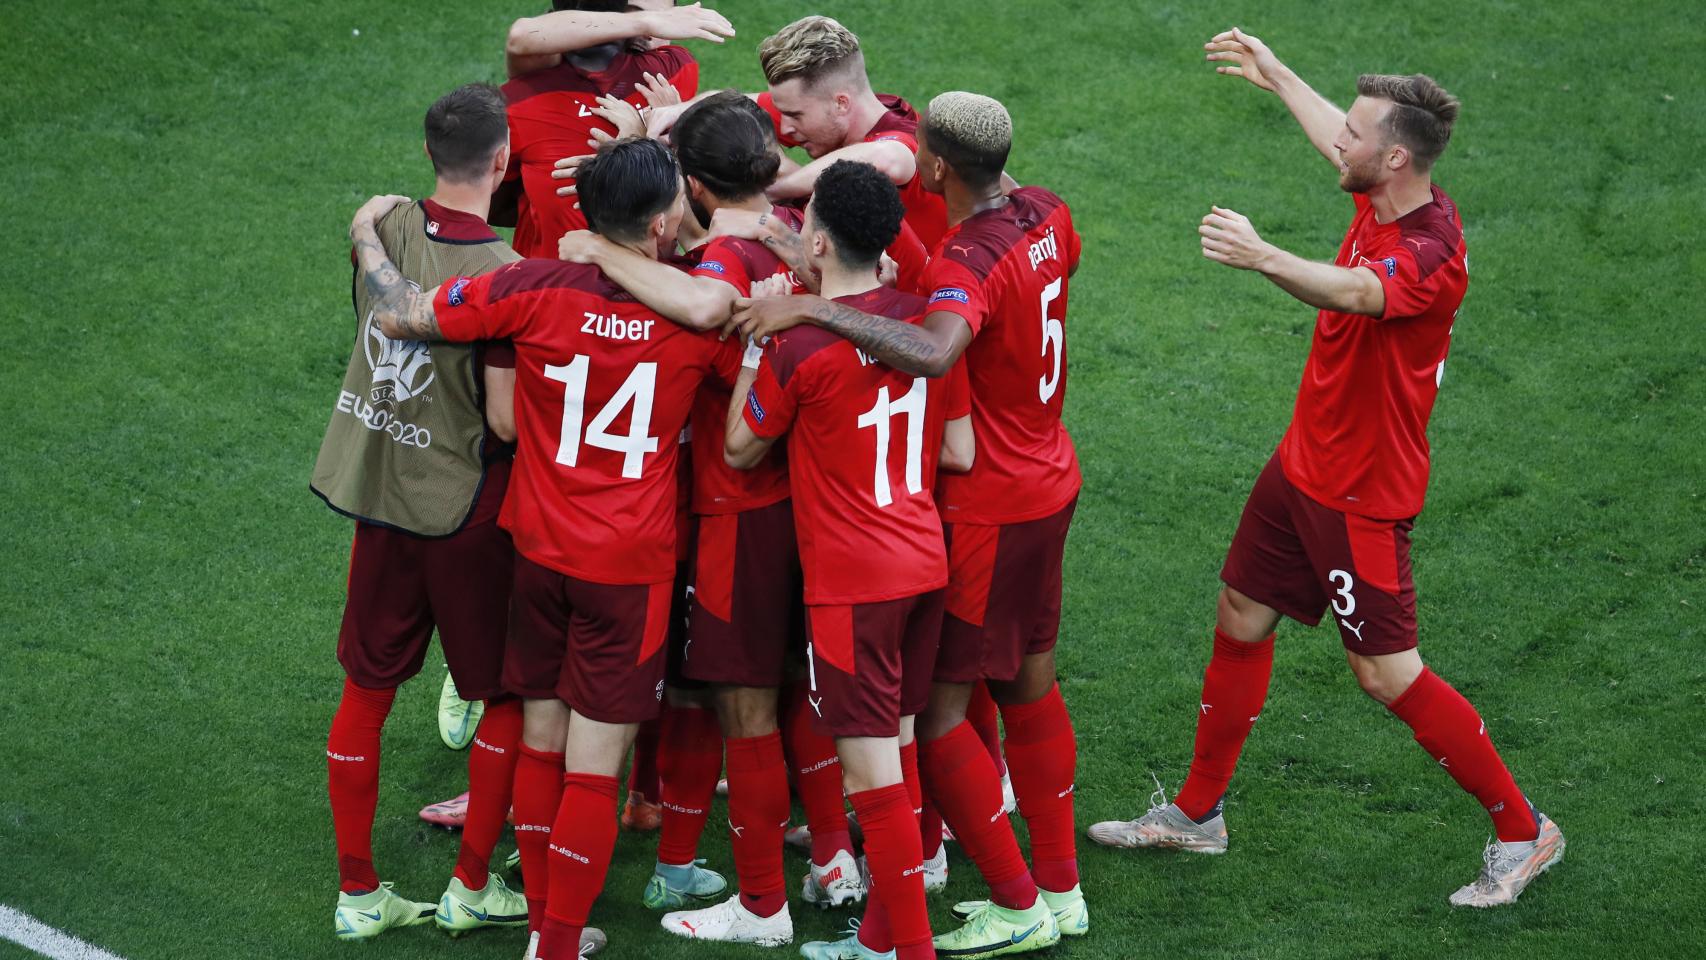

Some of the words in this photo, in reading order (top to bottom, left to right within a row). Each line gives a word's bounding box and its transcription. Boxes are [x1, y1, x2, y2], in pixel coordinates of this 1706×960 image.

[937, 291, 968, 300] RESPECT
[580, 312, 655, 341] zuber
[1039, 277, 1064, 404] 5
[543, 354, 658, 480] 14
[857, 376, 927, 508] 11
[1328, 569, 1357, 617] 3
[800, 756, 839, 773] suisse
[663, 801, 702, 814] suisse
[549, 843, 590, 864] suisse
